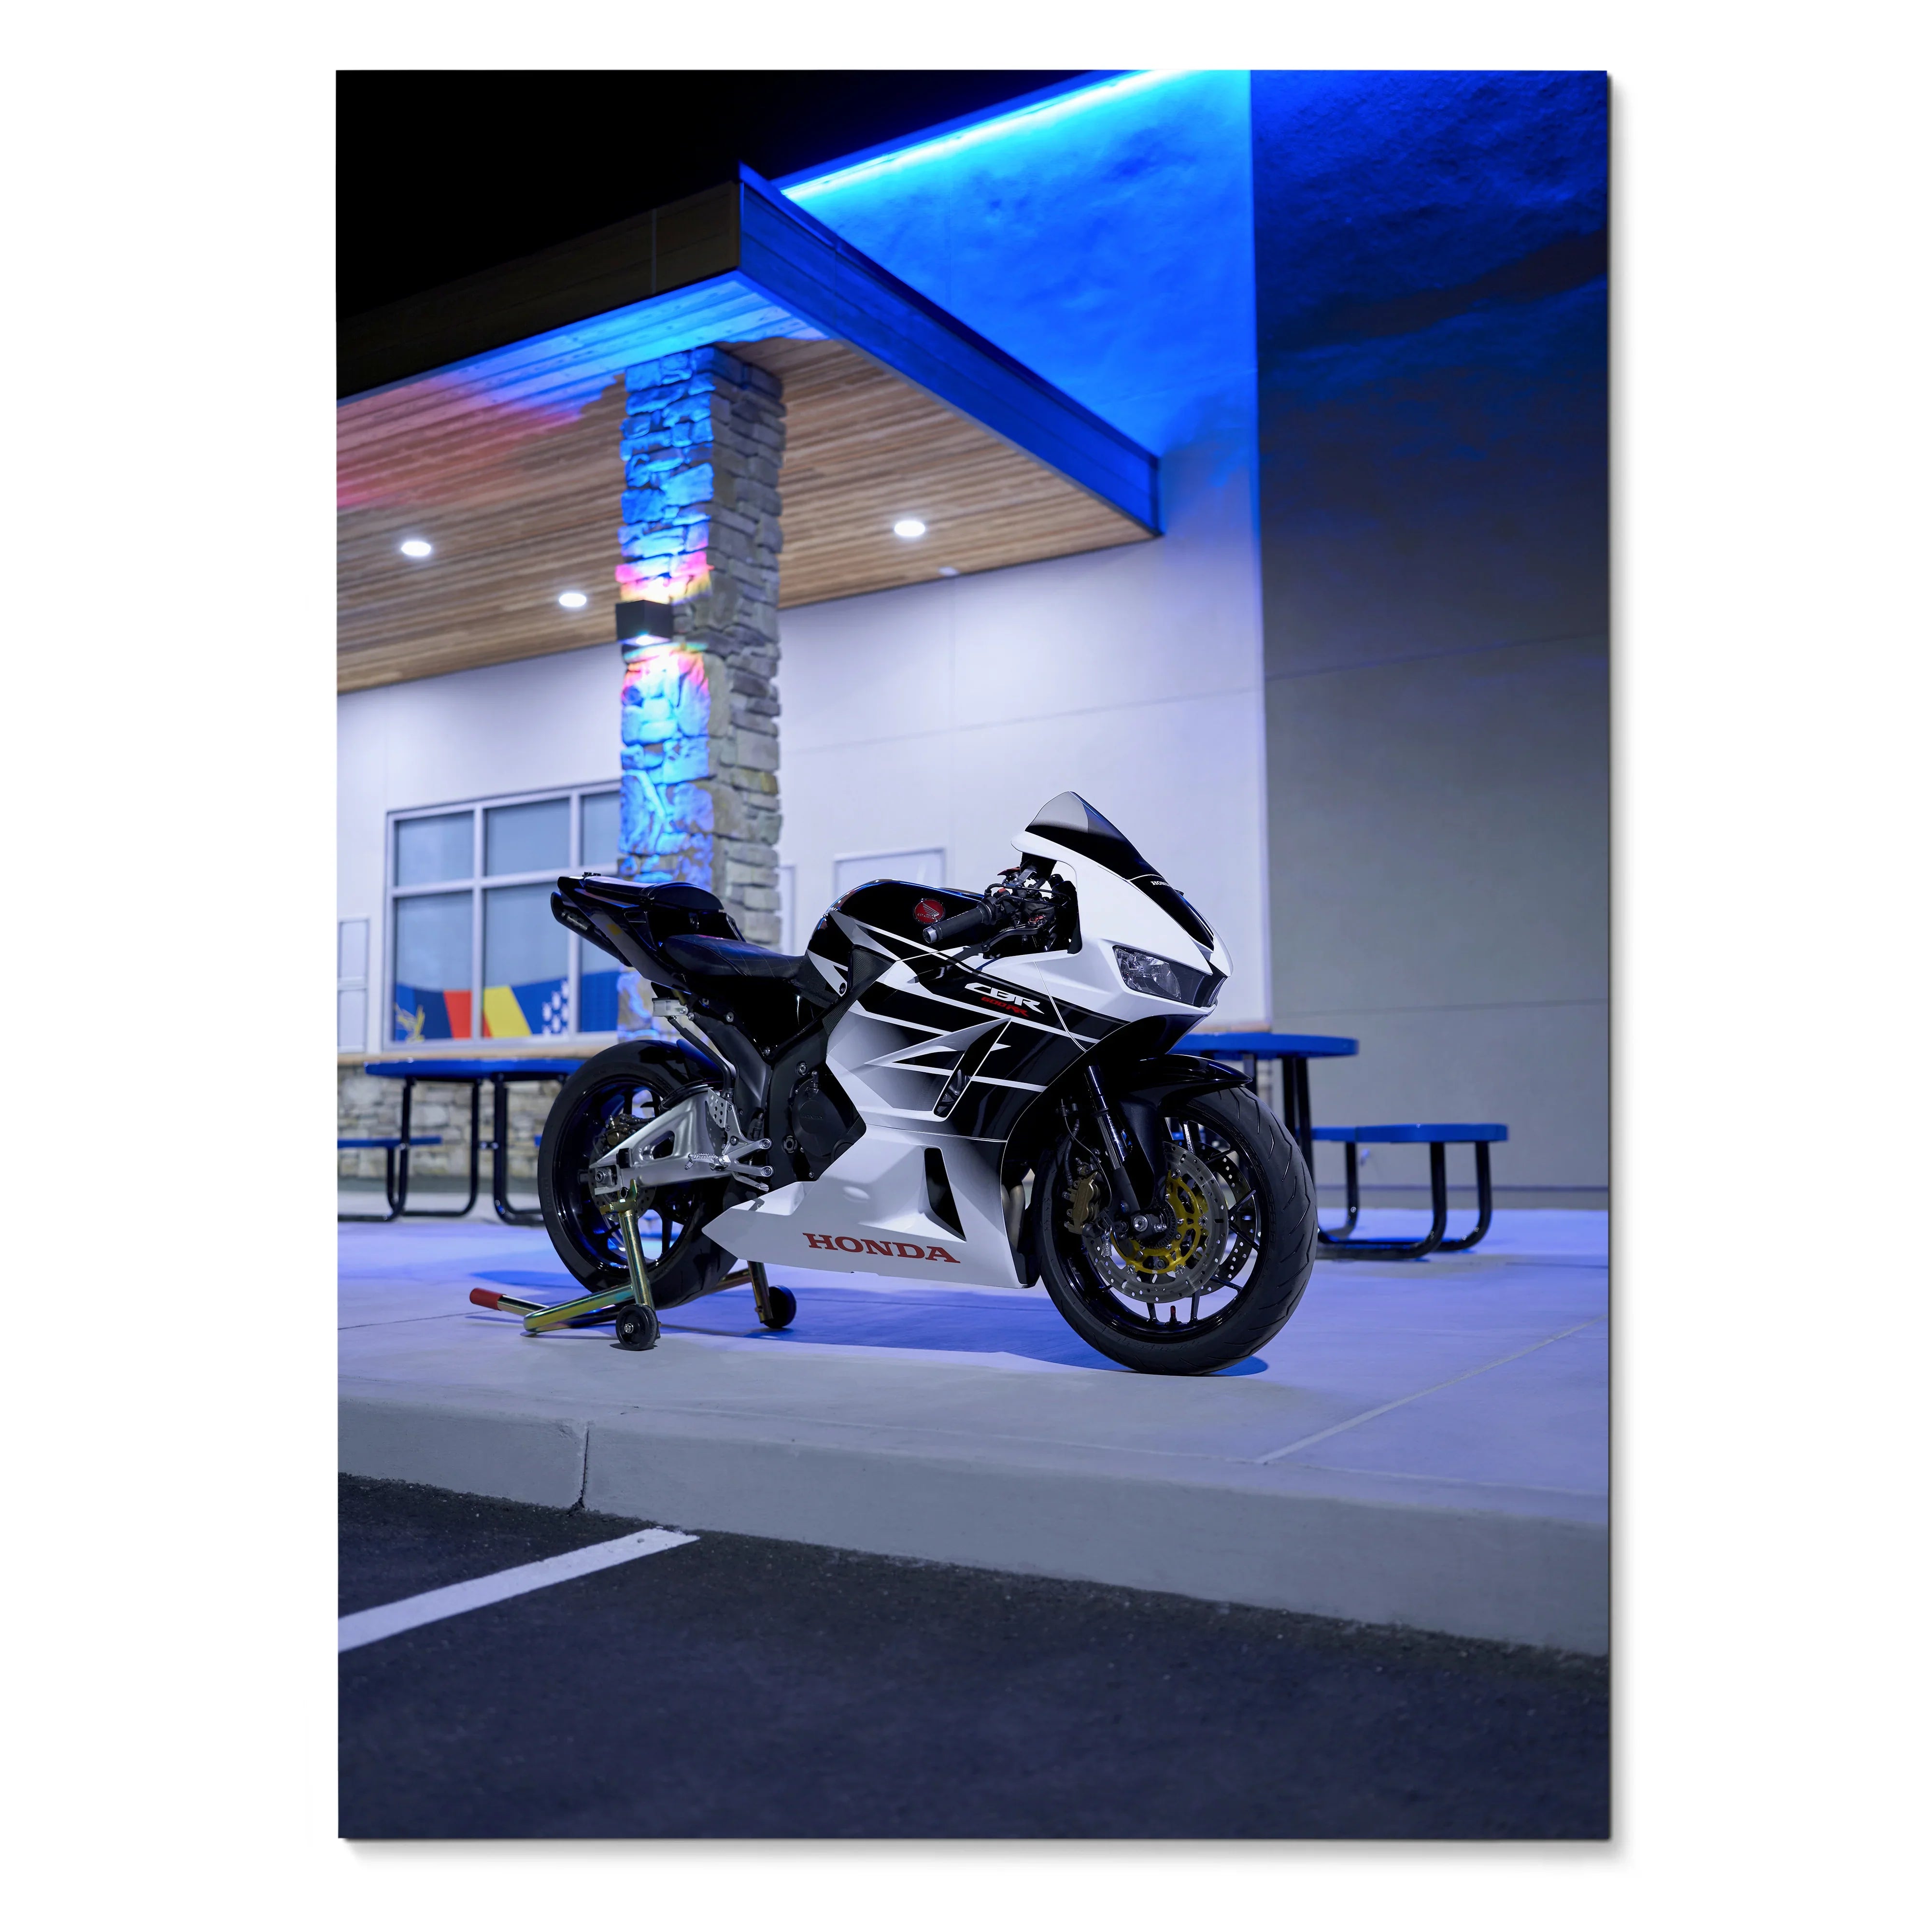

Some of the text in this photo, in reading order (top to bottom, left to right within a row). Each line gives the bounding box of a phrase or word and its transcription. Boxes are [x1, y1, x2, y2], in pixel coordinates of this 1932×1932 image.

[965, 982, 1045, 1014] CBR
[981, 996, 1028, 1017] 600RR
[802, 1233, 961, 1264] HONDA
